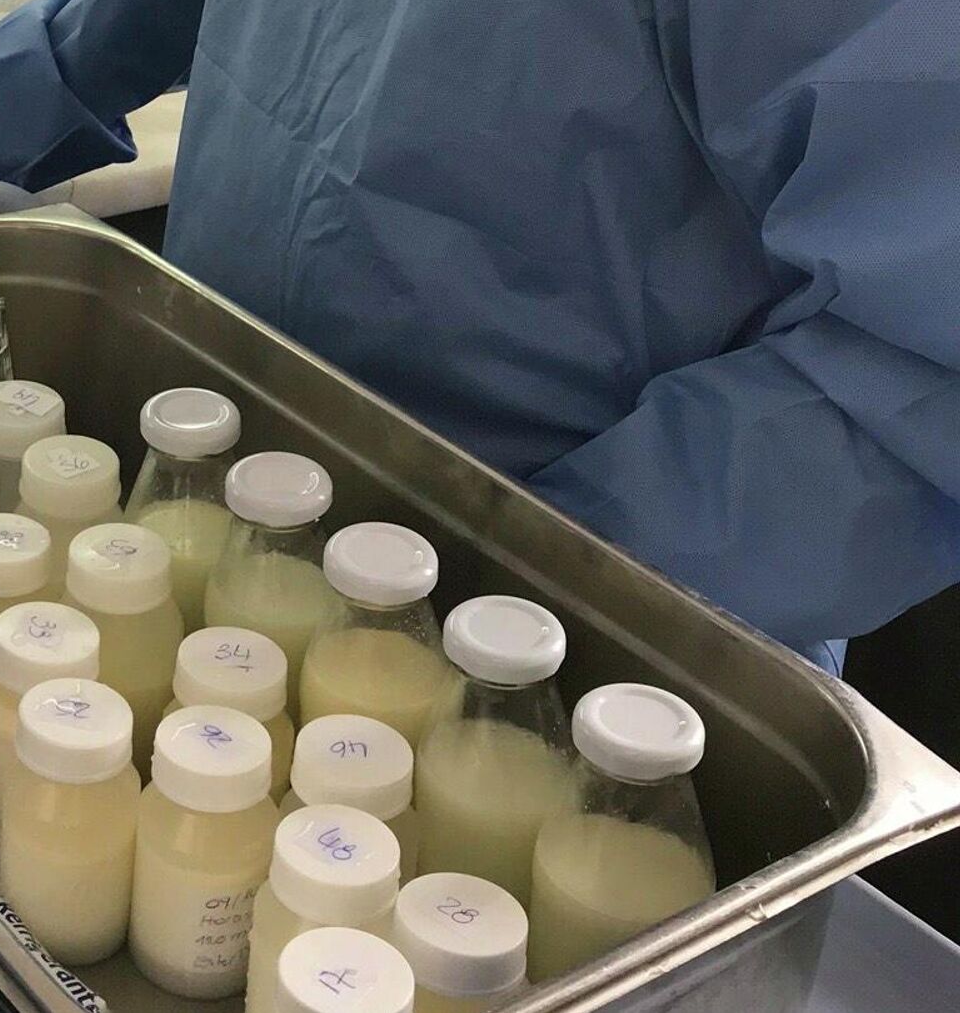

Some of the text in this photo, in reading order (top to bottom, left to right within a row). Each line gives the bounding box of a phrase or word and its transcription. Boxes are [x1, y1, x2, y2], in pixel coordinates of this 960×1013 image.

[214, 643, 253, 663] 34
[317, 827, 353, 862] 48
[436, 897, 480, 924] 28
